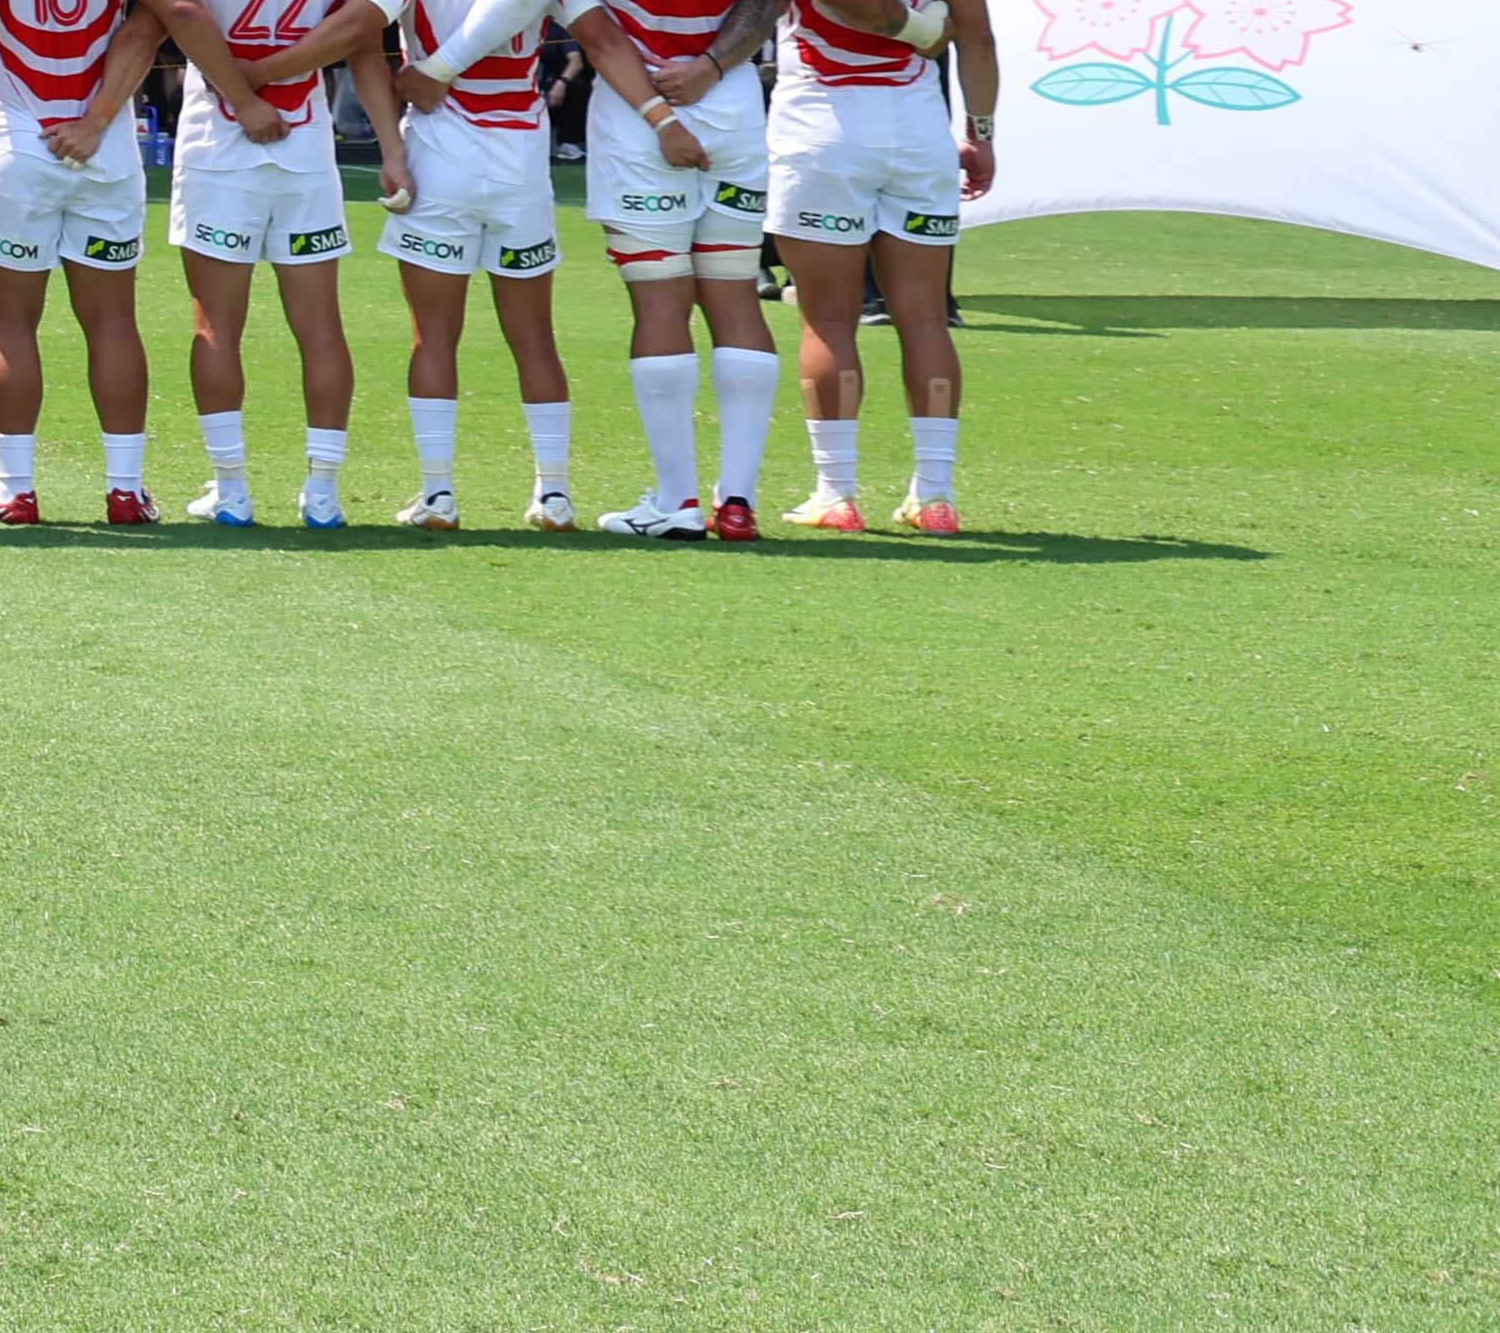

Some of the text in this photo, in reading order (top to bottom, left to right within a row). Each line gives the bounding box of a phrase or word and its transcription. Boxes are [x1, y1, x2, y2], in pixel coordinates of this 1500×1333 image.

[622, 194, 687, 213] SECOM
[798, 211, 865, 233] SECOM
[196, 224, 251, 251] SECOM
[400, 233, 463, 261] SECOM
